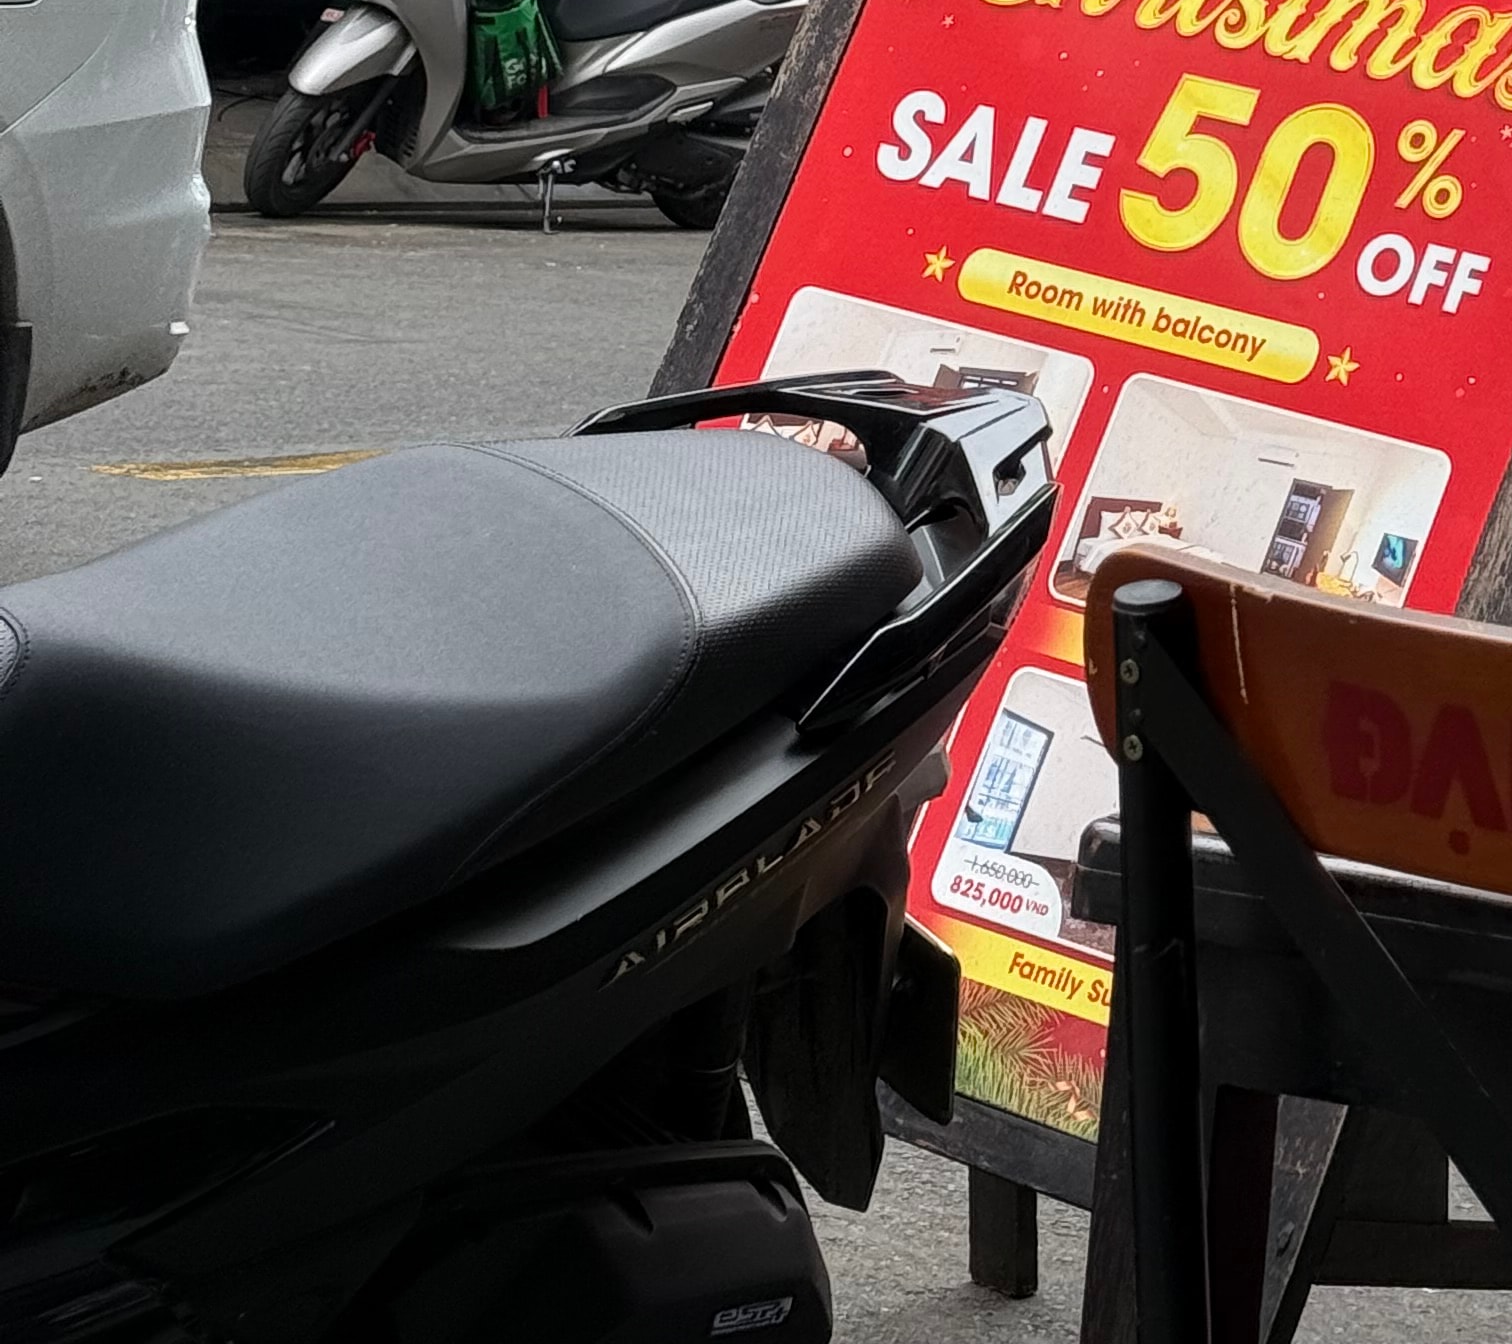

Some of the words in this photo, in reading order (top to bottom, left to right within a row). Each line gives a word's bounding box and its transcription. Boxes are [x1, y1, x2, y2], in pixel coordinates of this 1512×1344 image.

[876, 89, 1116, 226] SALE
[1356, 233, 1492, 315] OFF
[1007, 268, 1084, 312] Room
[1090, 287, 1145, 328] with
[1151, 302, 1268, 361] balcony
[949, 874, 1024, 914] 825,000
[1025, 899, 1049, 917] VND
[1007, 951, 1084, 1000] Family
